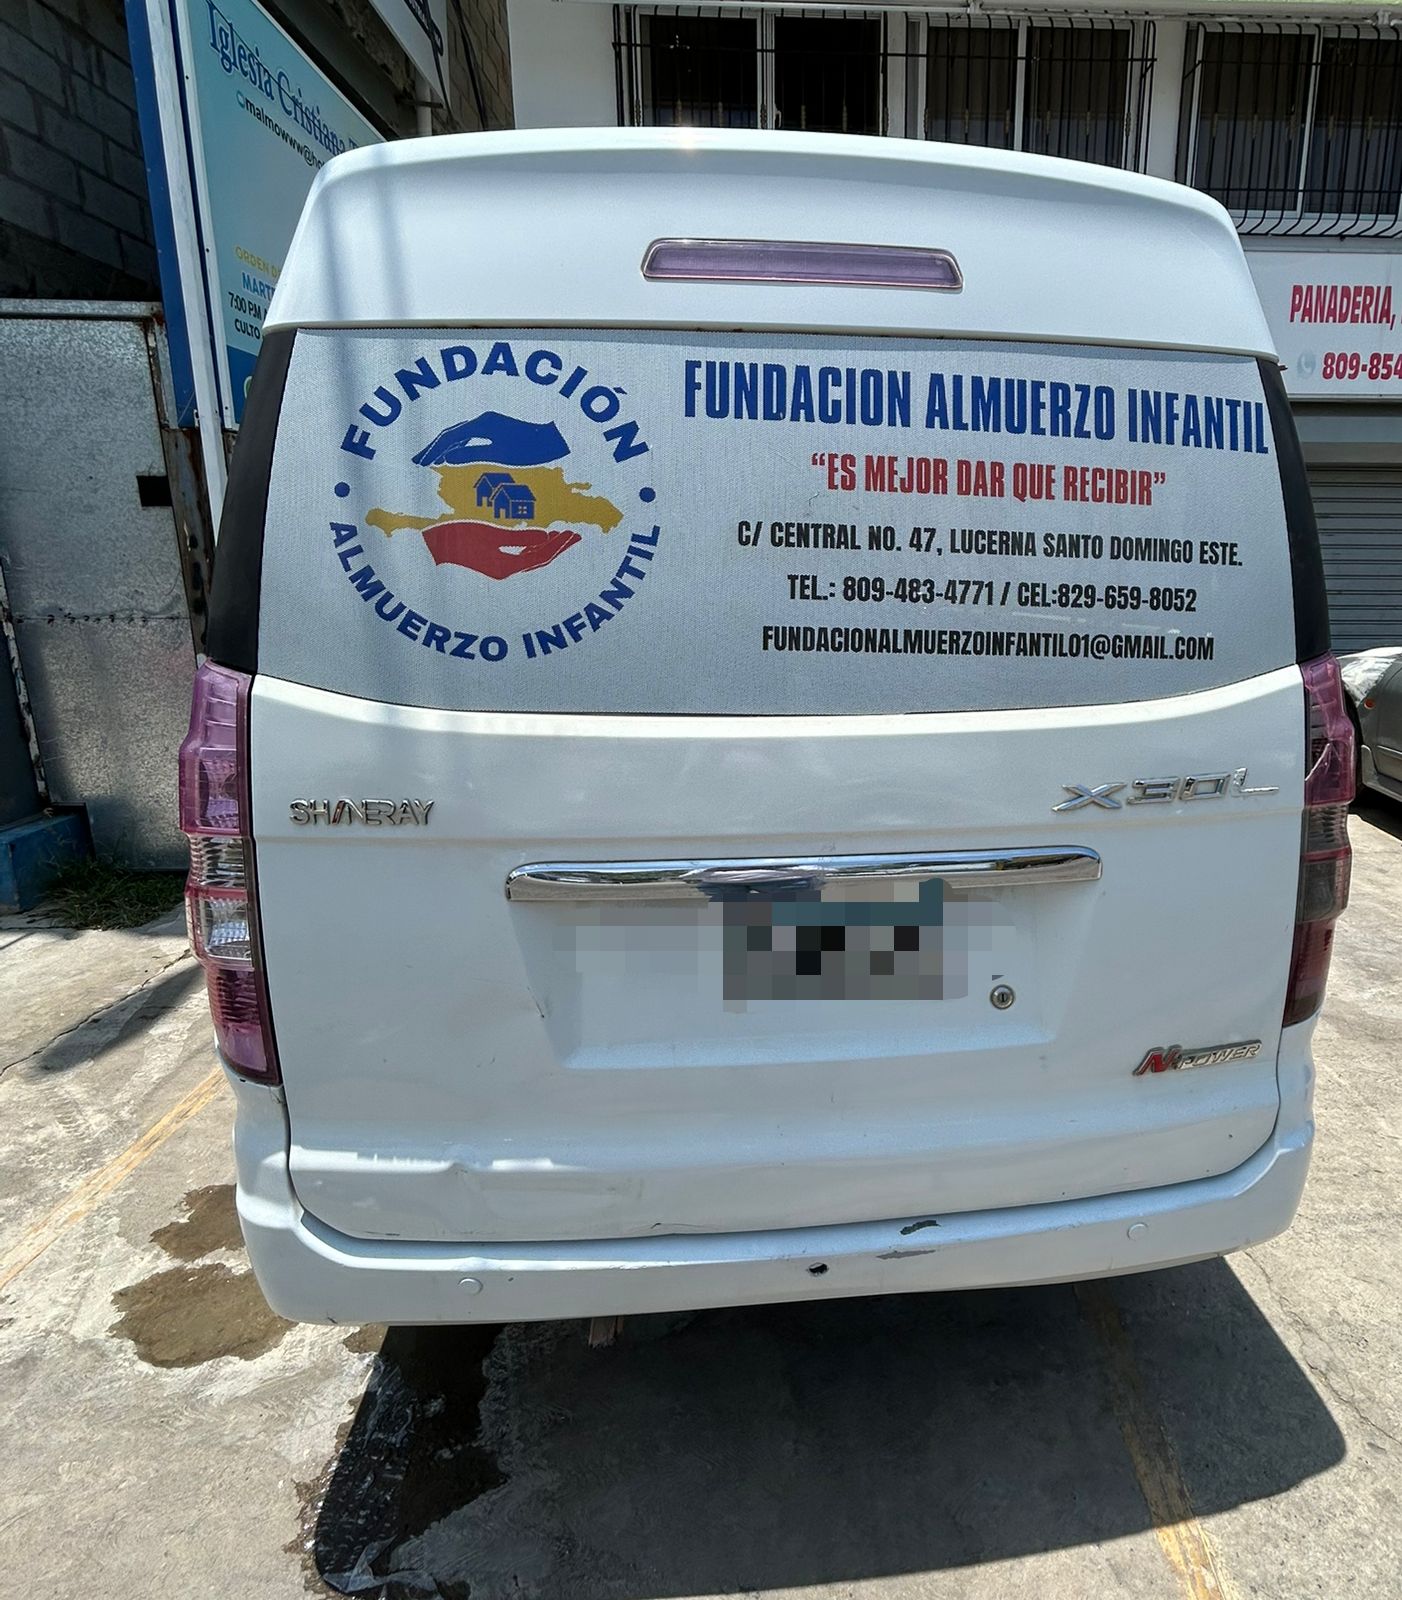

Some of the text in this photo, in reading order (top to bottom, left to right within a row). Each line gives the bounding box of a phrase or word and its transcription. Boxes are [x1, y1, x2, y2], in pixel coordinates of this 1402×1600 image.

[207, 2, 345, 156] Iglesia Cristiana
[245, 97, 326, 170] malmowww@ho
[235, 246, 269, 274] ORDEN
[228, 291, 247, 314] 7:00
[1290, 285, 1396, 331] PANADERIA,
[235, 319, 261, 340] CULTO
[340, 341, 650, 462] FUNDACIÓN
[684, 360, 1269, 454] FUNDACION ALMUERZO INFANTIL
[864, 455, 948, 495] MEJOR
[956, 459, 1005, 497] DAR
[1012, 462, 1056, 502] QUE
[737, 521, 1243, 567] C/ CENTRAL NO. 47, LUCERNA SANTO DOMINGO ESTE.
[329, 521, 661, 662] ALMUERZO INFANTIL
[787, 574, 1197, 612] TEL.: 809-483-4771 / CEL:829-659-8052
[762, 625, 1214, 660] FUNDACIONALMUERZOINFANTIL01@GMAIL.COM
[289, 798, 435, 826] SHINERAY
[1052, 767, 1279, 812] X30L
